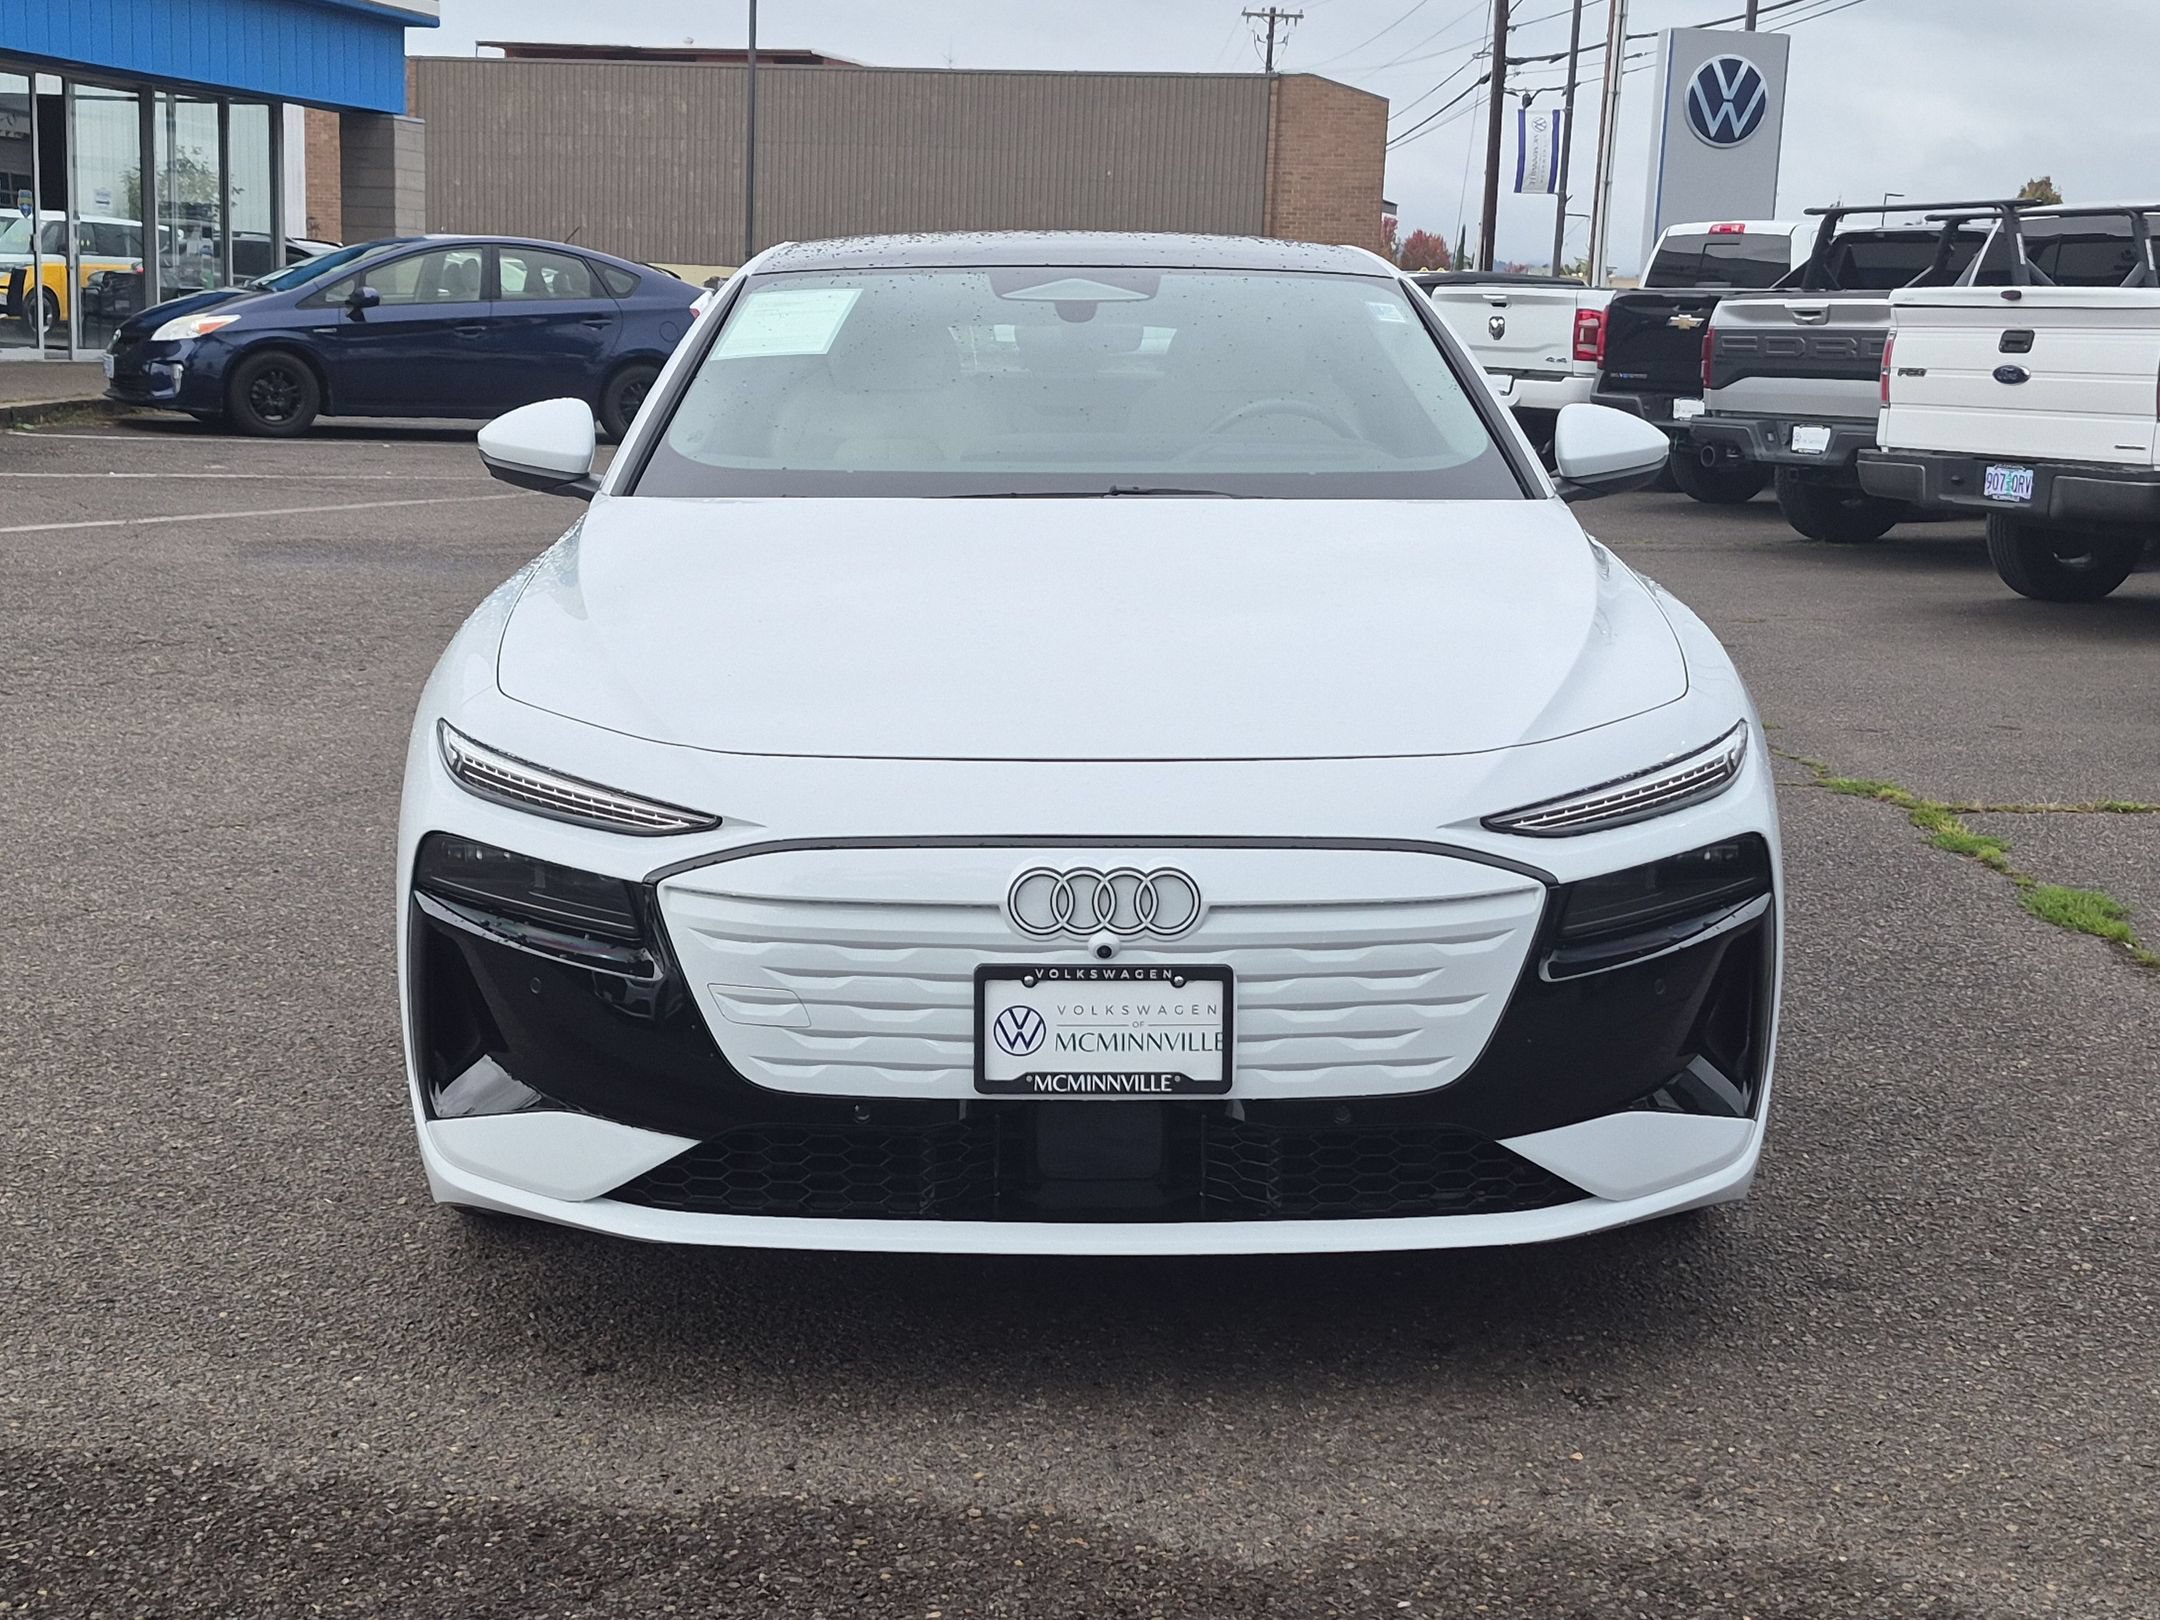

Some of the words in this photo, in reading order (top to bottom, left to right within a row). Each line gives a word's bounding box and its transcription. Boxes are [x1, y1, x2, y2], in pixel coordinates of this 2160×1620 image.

[1986, 472, 2006, 492] 907
[1034, 968, 1173, 980] VOLKSWAGEN
[1056, 1004, 1218, 1016] VOLKSWAGEN
[1131, 1020, 1145, 1029] OF
[1054, 1031, 1223, 1052] MCMINNVILLE
[1033, 1074, 1173, 1092] MCMINNVILLE
